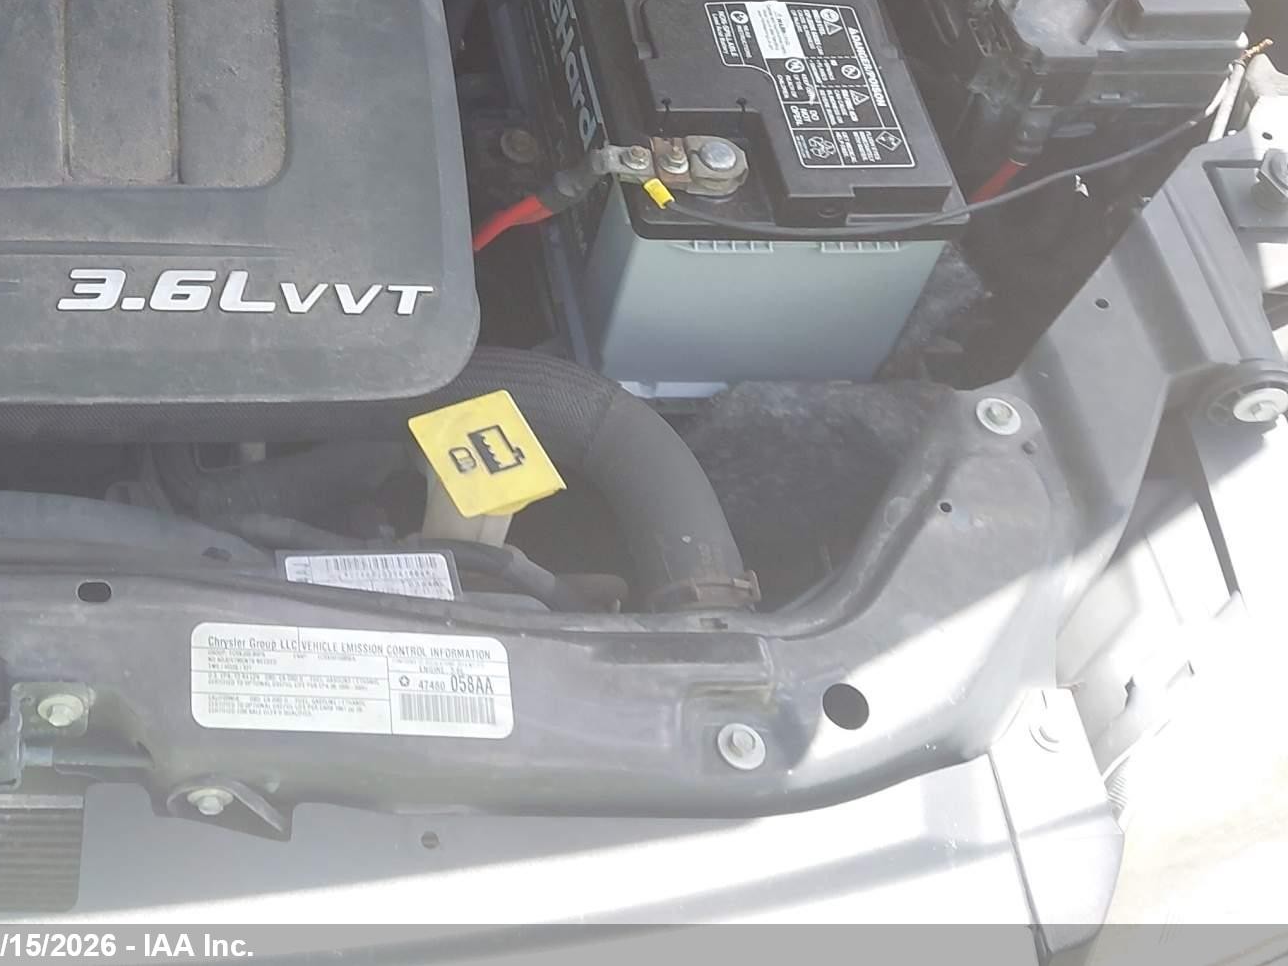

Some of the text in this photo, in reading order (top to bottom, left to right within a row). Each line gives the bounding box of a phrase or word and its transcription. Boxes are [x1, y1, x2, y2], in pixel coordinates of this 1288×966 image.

[715, 11, 740, 57] NON-SPILLABLE
[851, 35, 887, 106] DANGER/POISON
[800, 108, 811, 122] NOT
[809, 110, 820, 121] DO
[57, 268, 434, 314] 3.6L VVT
[208, 636, 491, 660] Chrysler Group LLC VEHICLE EMISSION CONTROL INFORMATION
[450, 674, 495, 695] 058AA
